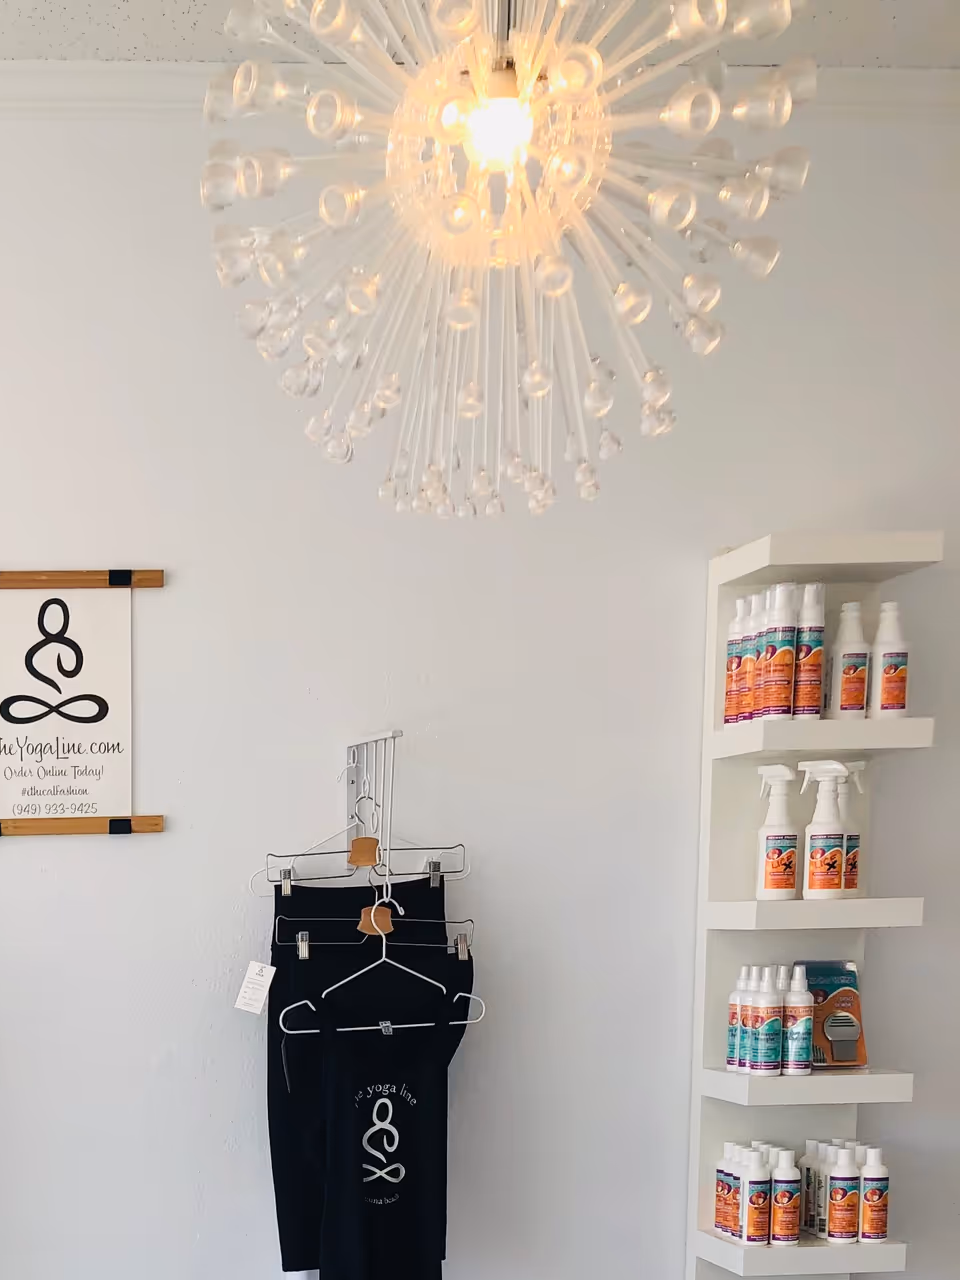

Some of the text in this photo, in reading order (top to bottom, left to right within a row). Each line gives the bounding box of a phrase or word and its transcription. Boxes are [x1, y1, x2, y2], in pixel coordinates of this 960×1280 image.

[3, 765, 104, 781] Order Online Today!
[12, 802, 98, 816] (949) 933-9425
[366, 1083, 417, 1107] yoga line
